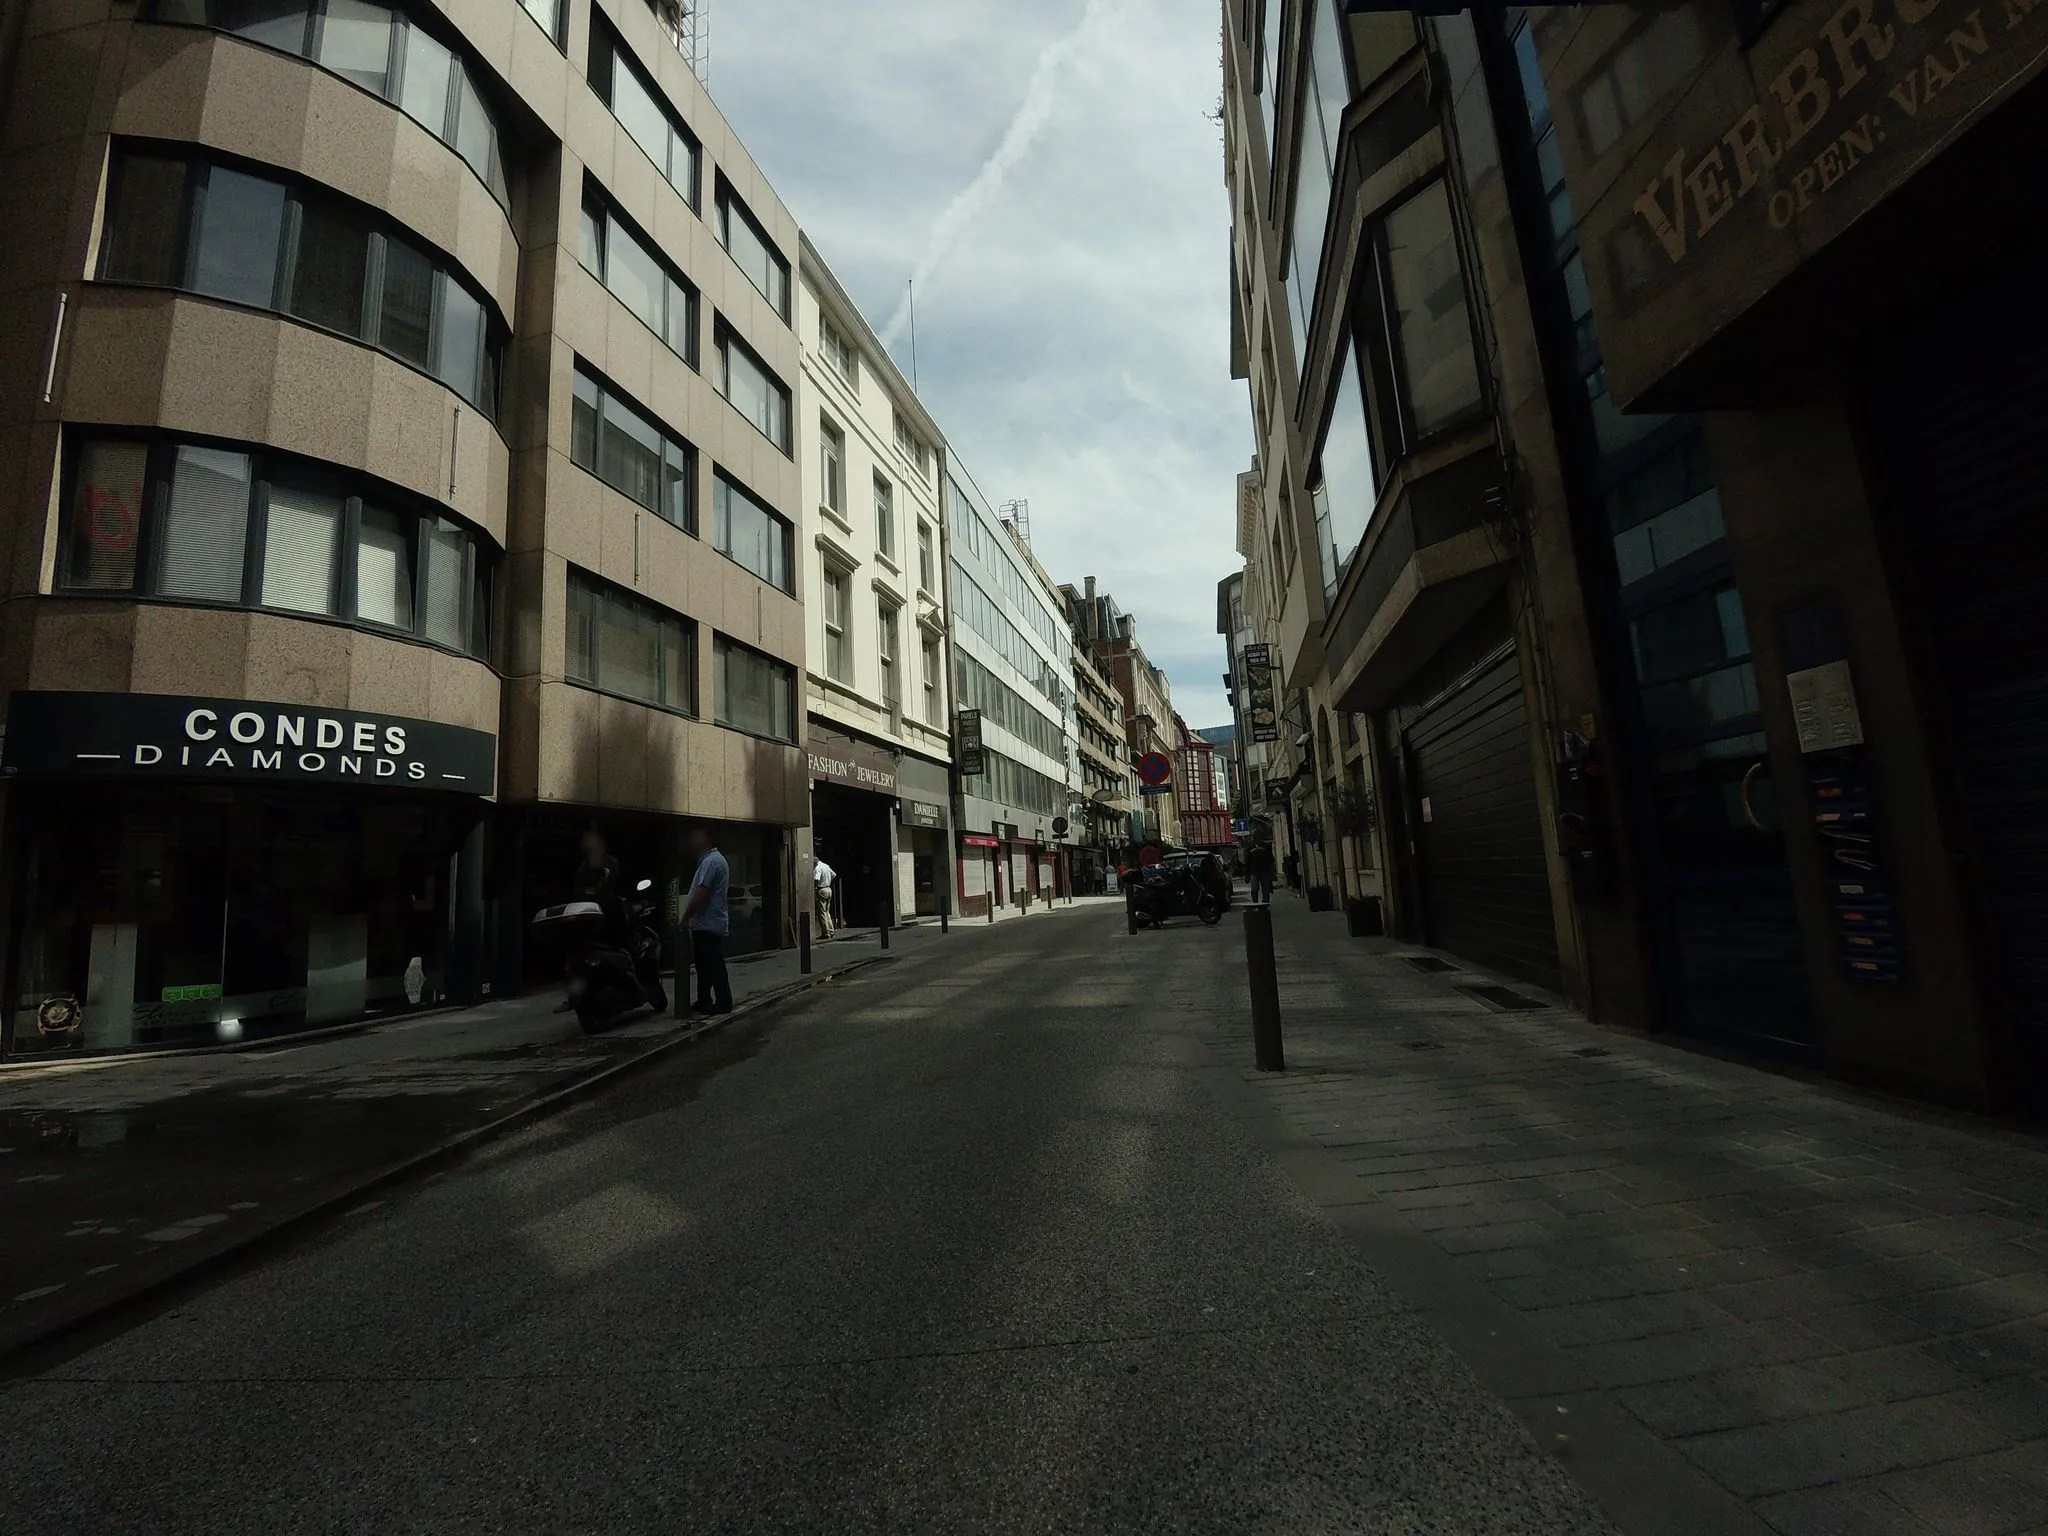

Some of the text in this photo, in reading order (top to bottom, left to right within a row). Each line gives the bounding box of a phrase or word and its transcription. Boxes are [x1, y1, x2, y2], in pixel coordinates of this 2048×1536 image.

[1767, 9, 1989, 230] OPEN: VAN
[184, 708, 407, 755] CONDES
[134, 744, 427, 779] DIAMONDS
[807, 753, 848, 777] FASHION
[857, 766, 894, 788] JEWELERY
